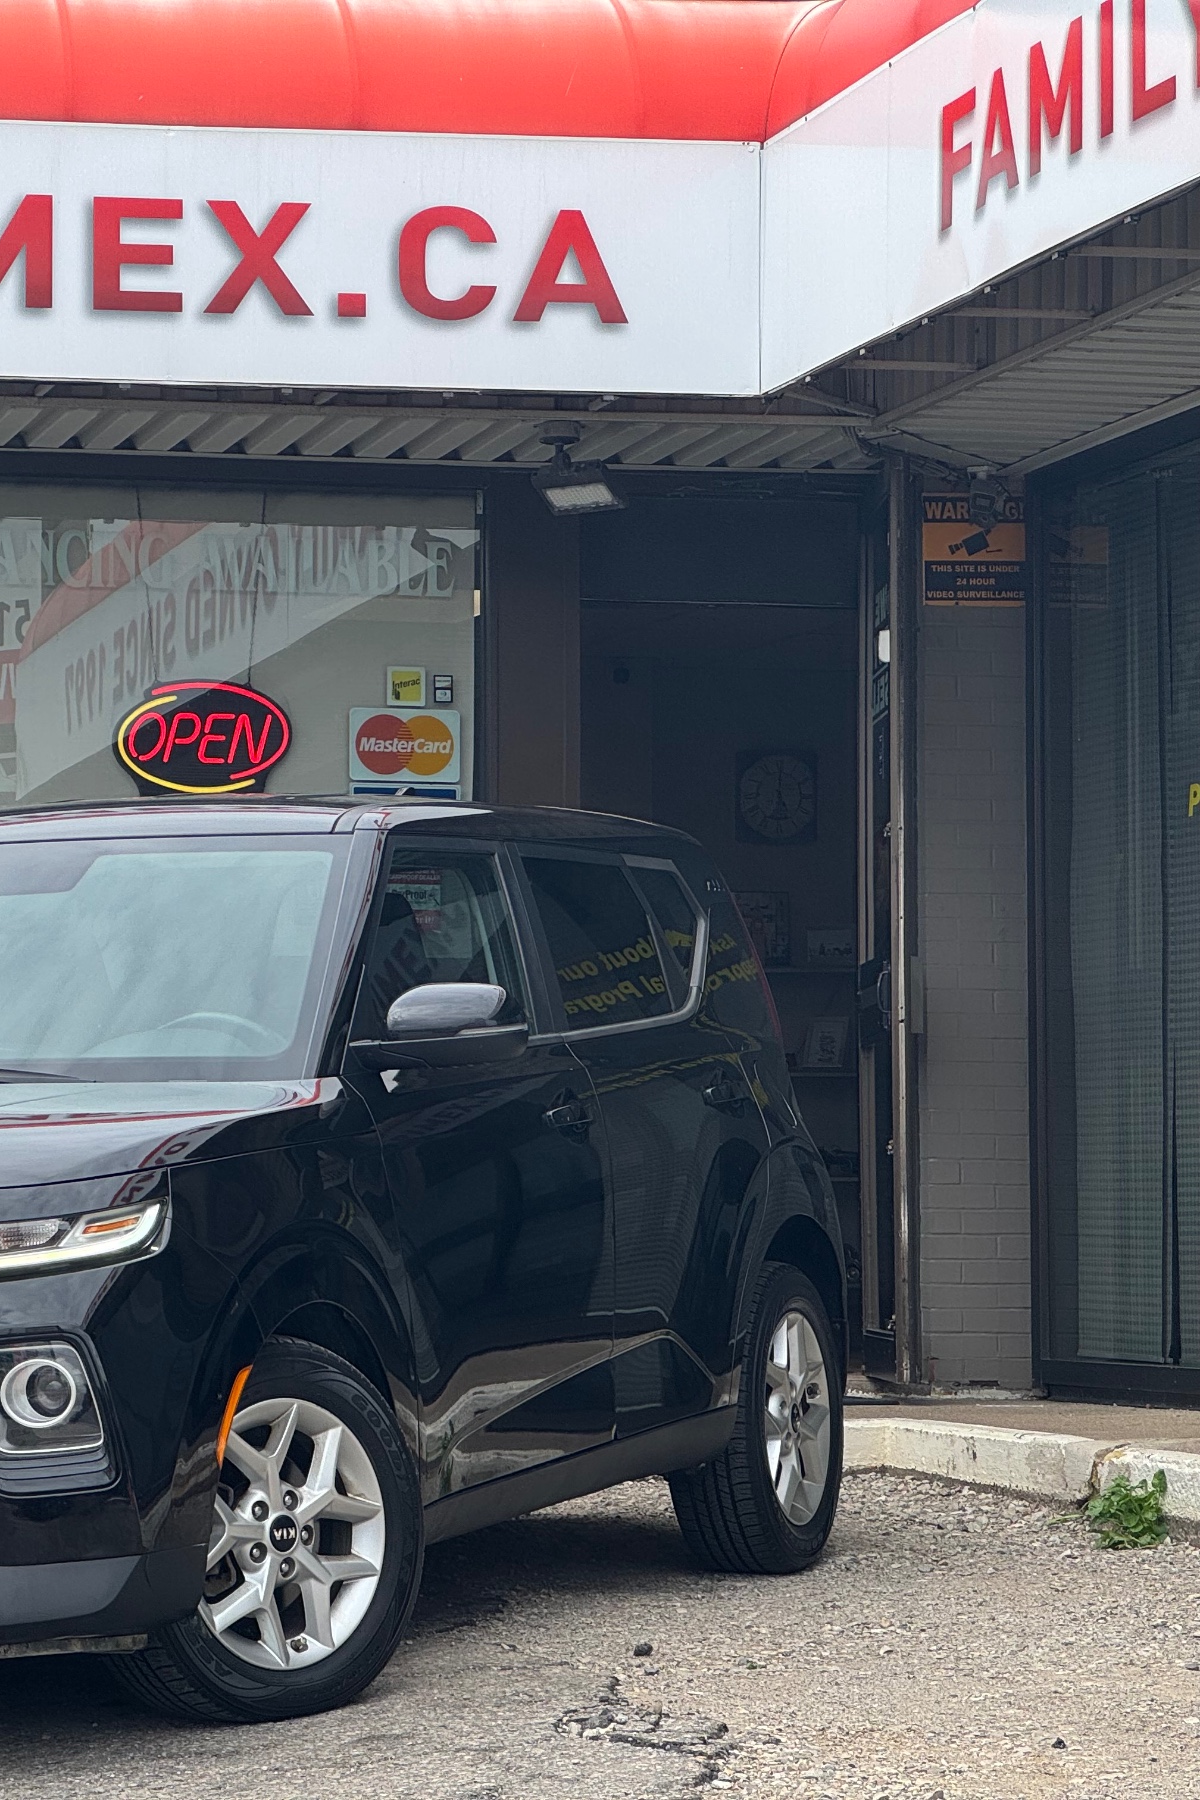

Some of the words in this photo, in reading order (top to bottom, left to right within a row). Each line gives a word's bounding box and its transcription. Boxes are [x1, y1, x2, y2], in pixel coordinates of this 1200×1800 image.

[925, 501, 1024, 520] WARG!
[200, 532, 456, 598] AVAILABLE
[392, 678, 421, 690] Interac
[128, 711, 274, 765] OPEN
[359, 737, 452, 754] MasterCard
